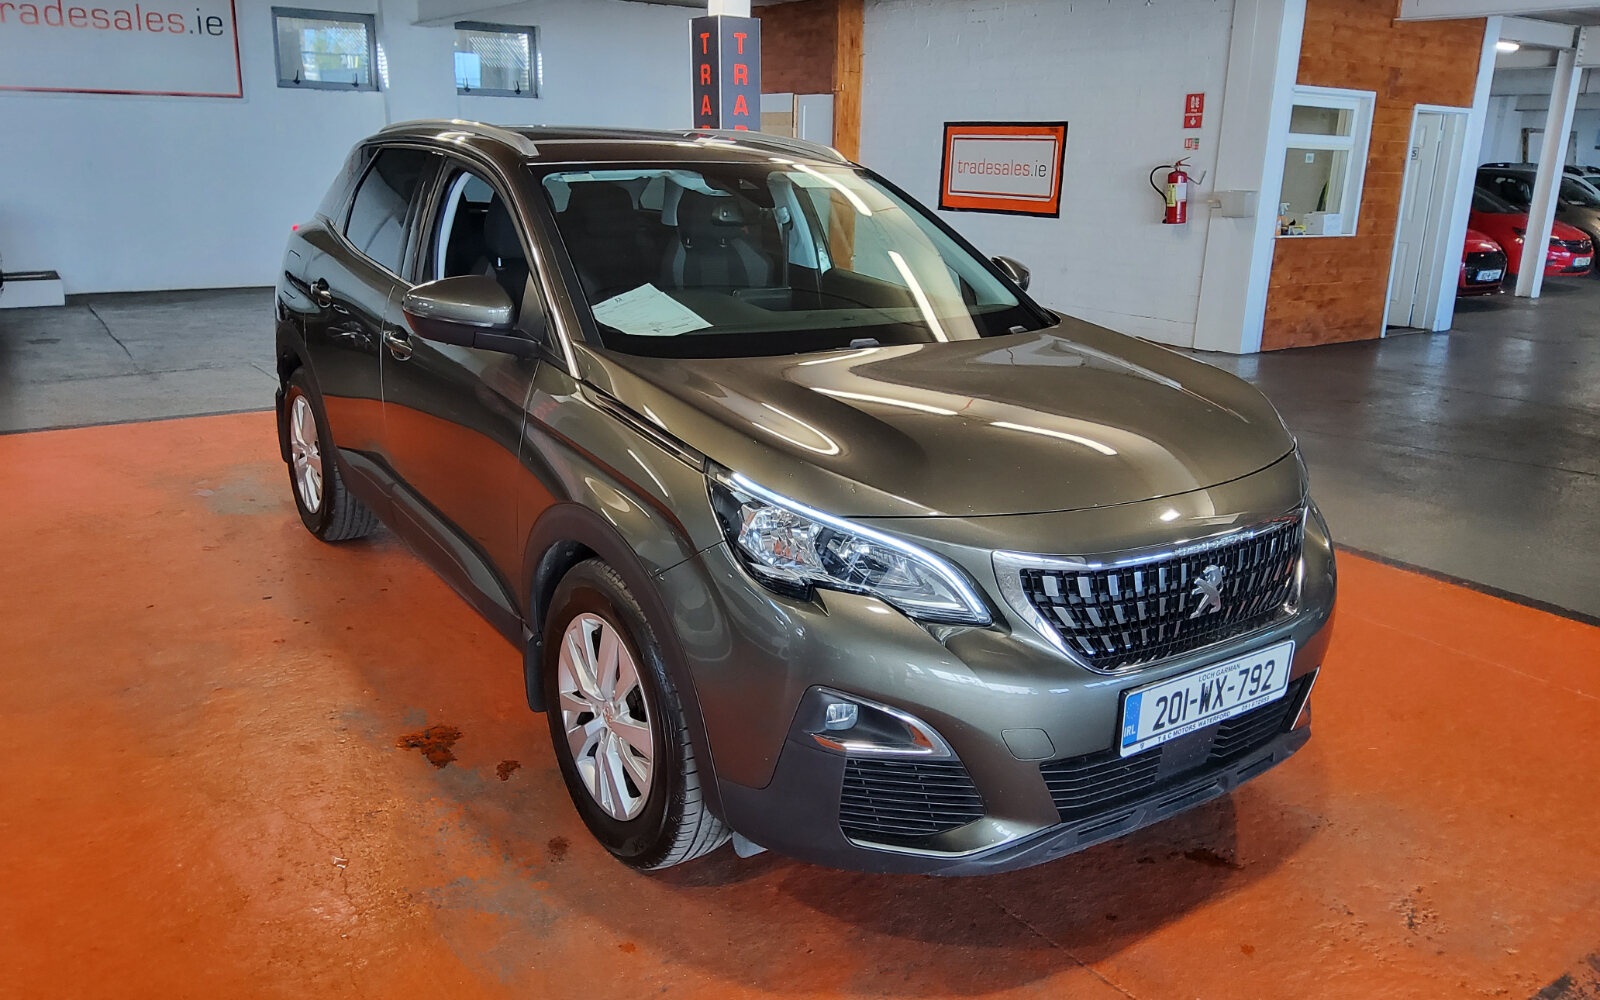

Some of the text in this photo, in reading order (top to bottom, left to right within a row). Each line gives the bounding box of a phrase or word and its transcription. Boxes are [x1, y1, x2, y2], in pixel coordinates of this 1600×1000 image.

[700, 32, 712, 129] TRA
[733, 32, 749, 131] TRA
[957, 158, 1047, 178] tradesales.ie
[1198, 663, 1241, 683] LOCH GARMAN
[1152, 659, 1275, 732] 201-WX-792
[1123, 724, 1136, 738] IRL
[1172, 724, 1197, 737] MOTORS
[1198, 711, 1231, 727] WATERFORD
